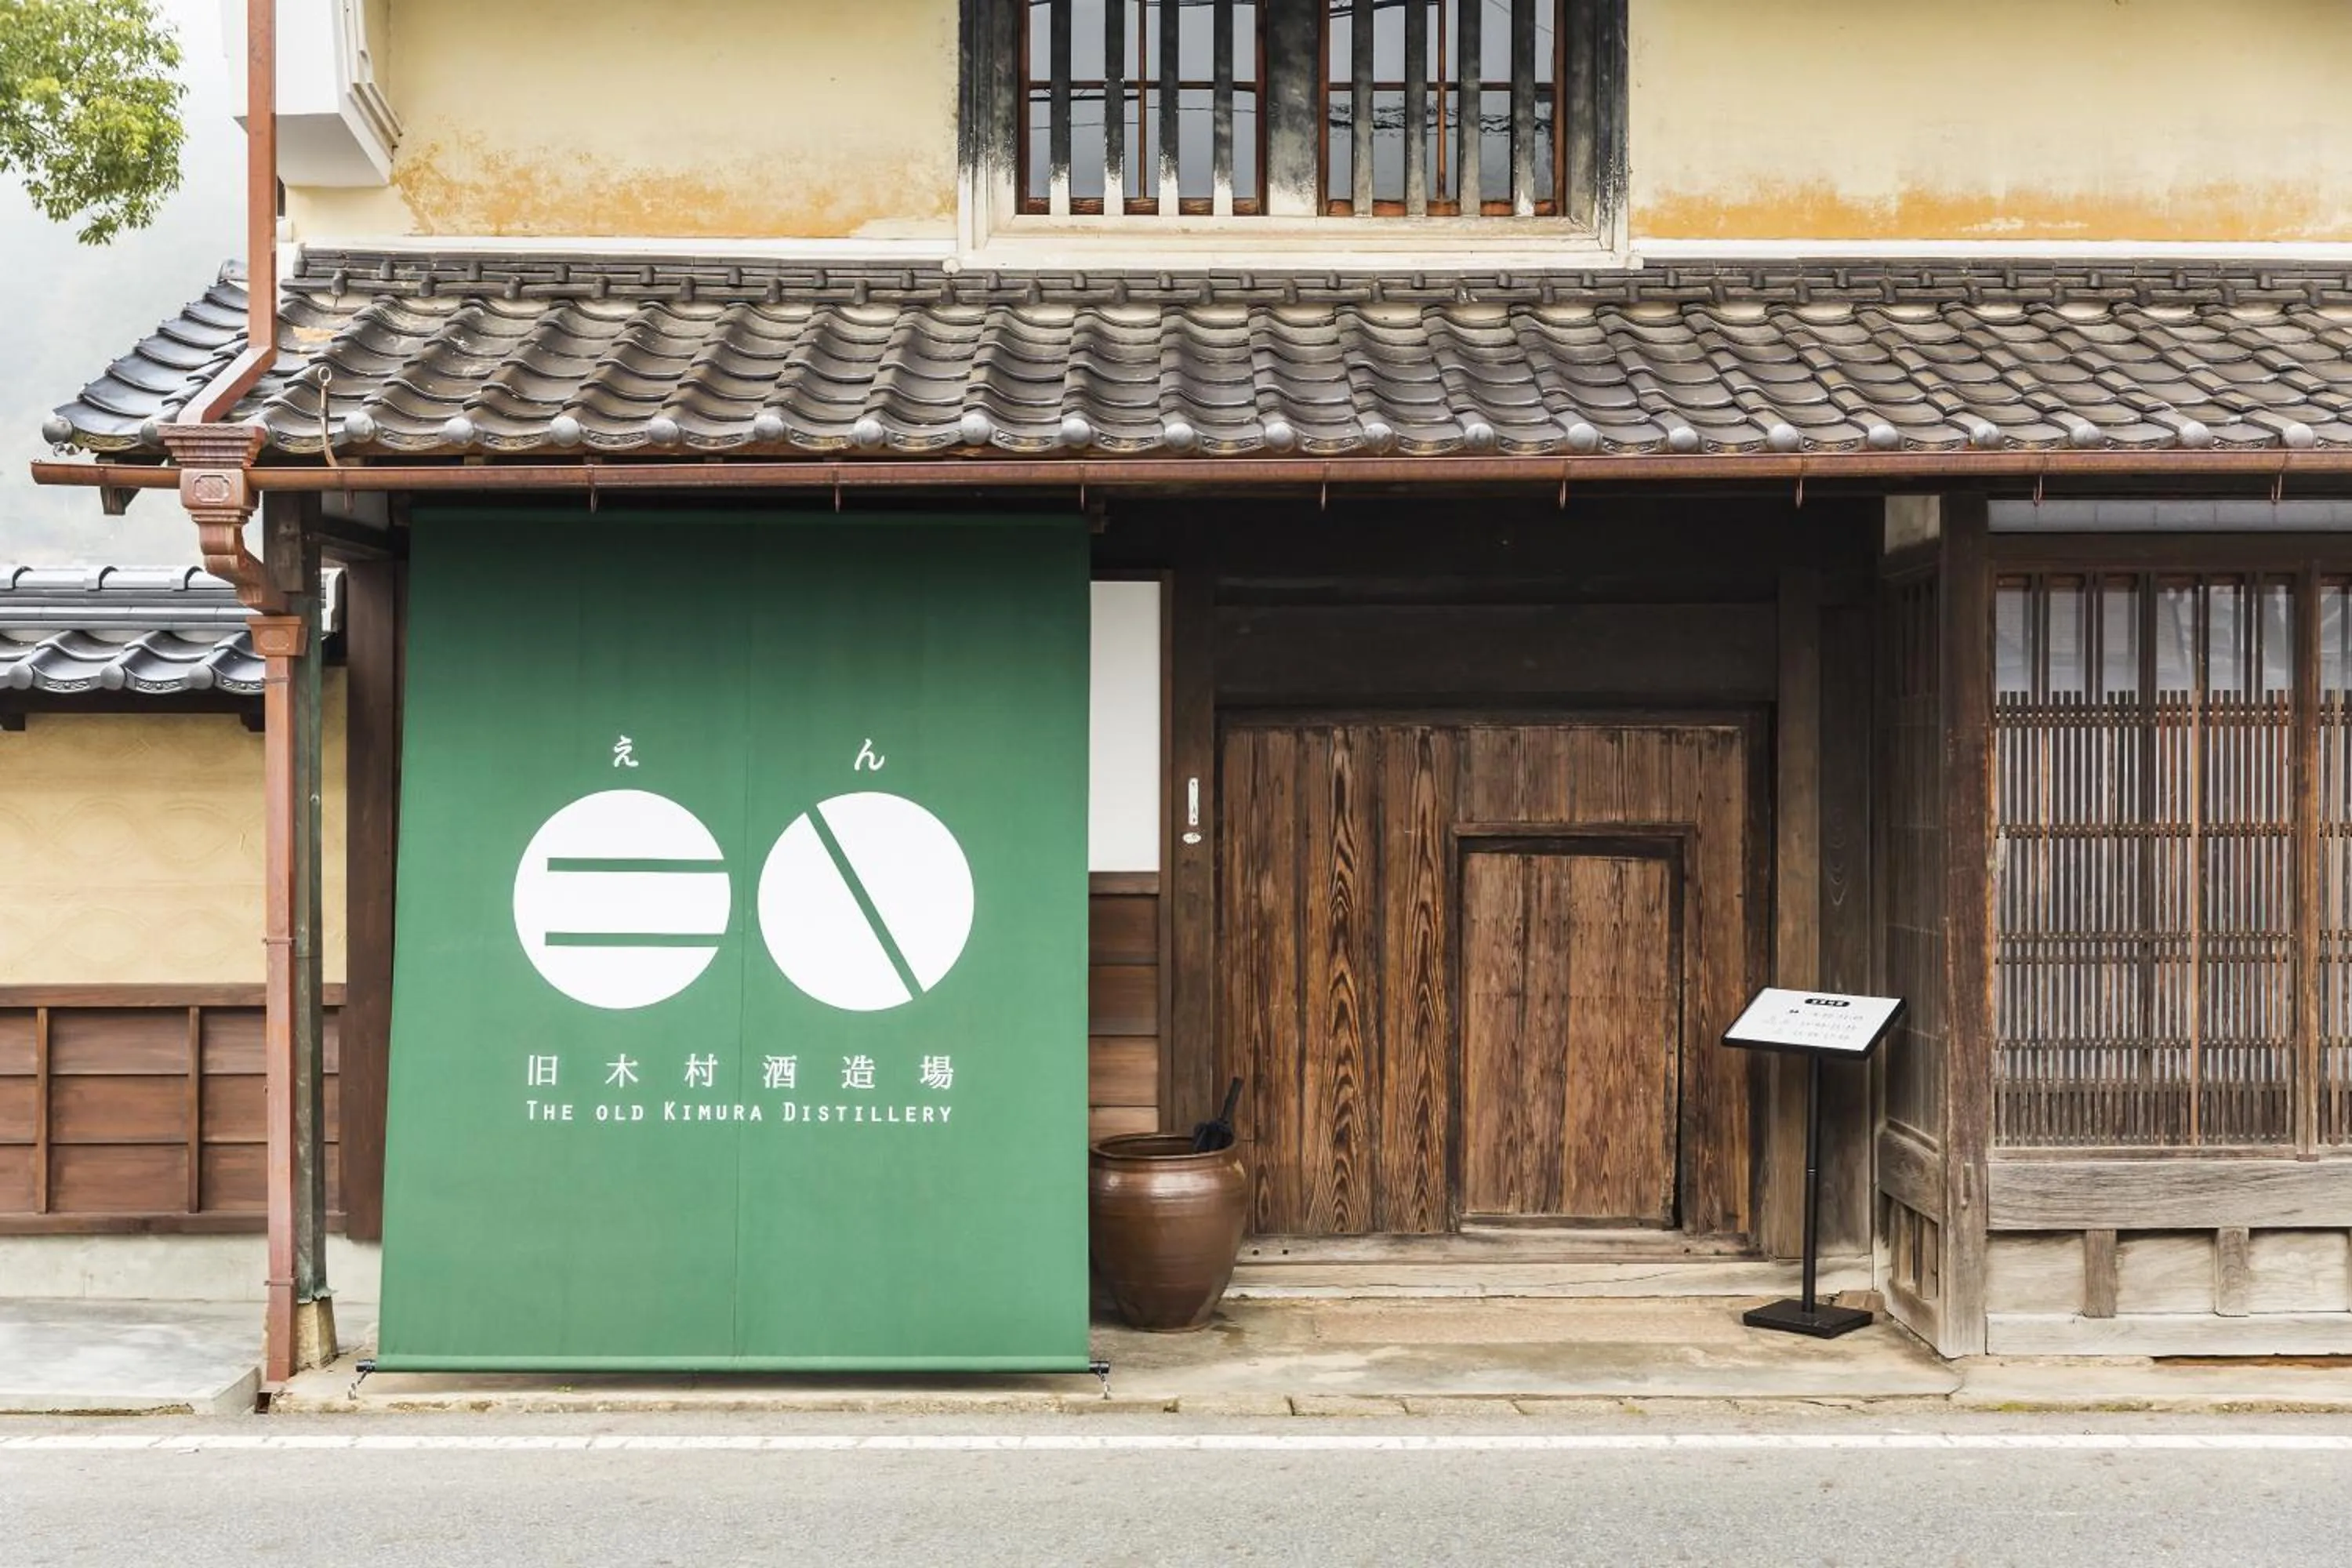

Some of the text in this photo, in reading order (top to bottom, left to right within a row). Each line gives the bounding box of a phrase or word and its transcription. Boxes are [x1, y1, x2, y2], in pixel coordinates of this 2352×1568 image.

[612, 735, 885, 771] え ん
[527, 1053, 954, 1090] 旧木村酒造場
